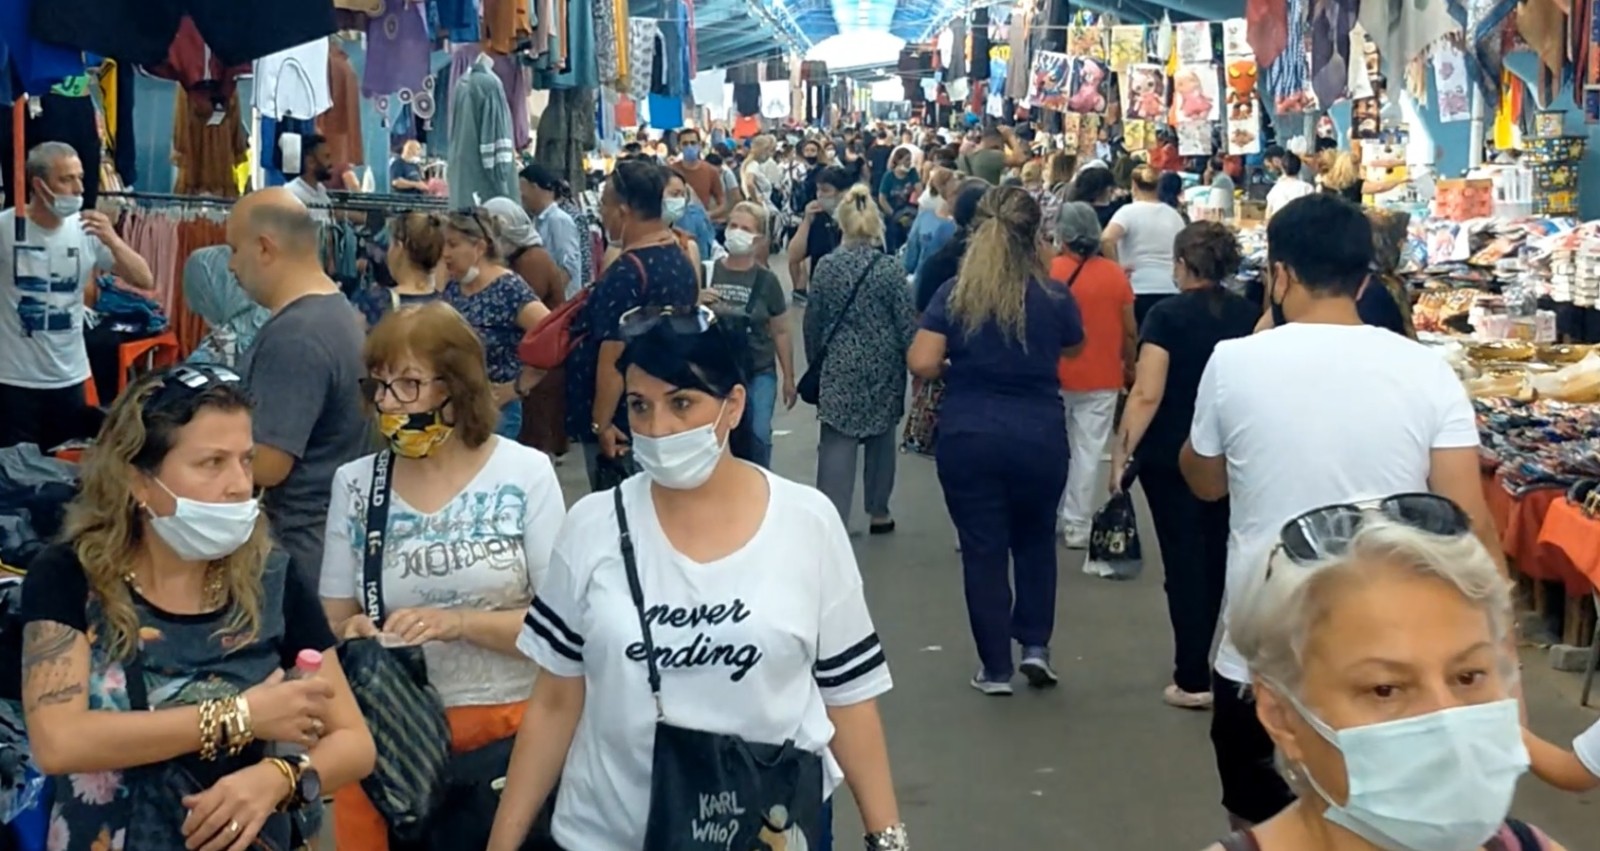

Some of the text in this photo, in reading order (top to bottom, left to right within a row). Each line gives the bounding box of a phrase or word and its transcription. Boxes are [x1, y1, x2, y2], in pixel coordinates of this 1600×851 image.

[643, 598, 751, 628] never
[625, 633, 763, 682] ending
[699, 790, 746, 820] KARL
